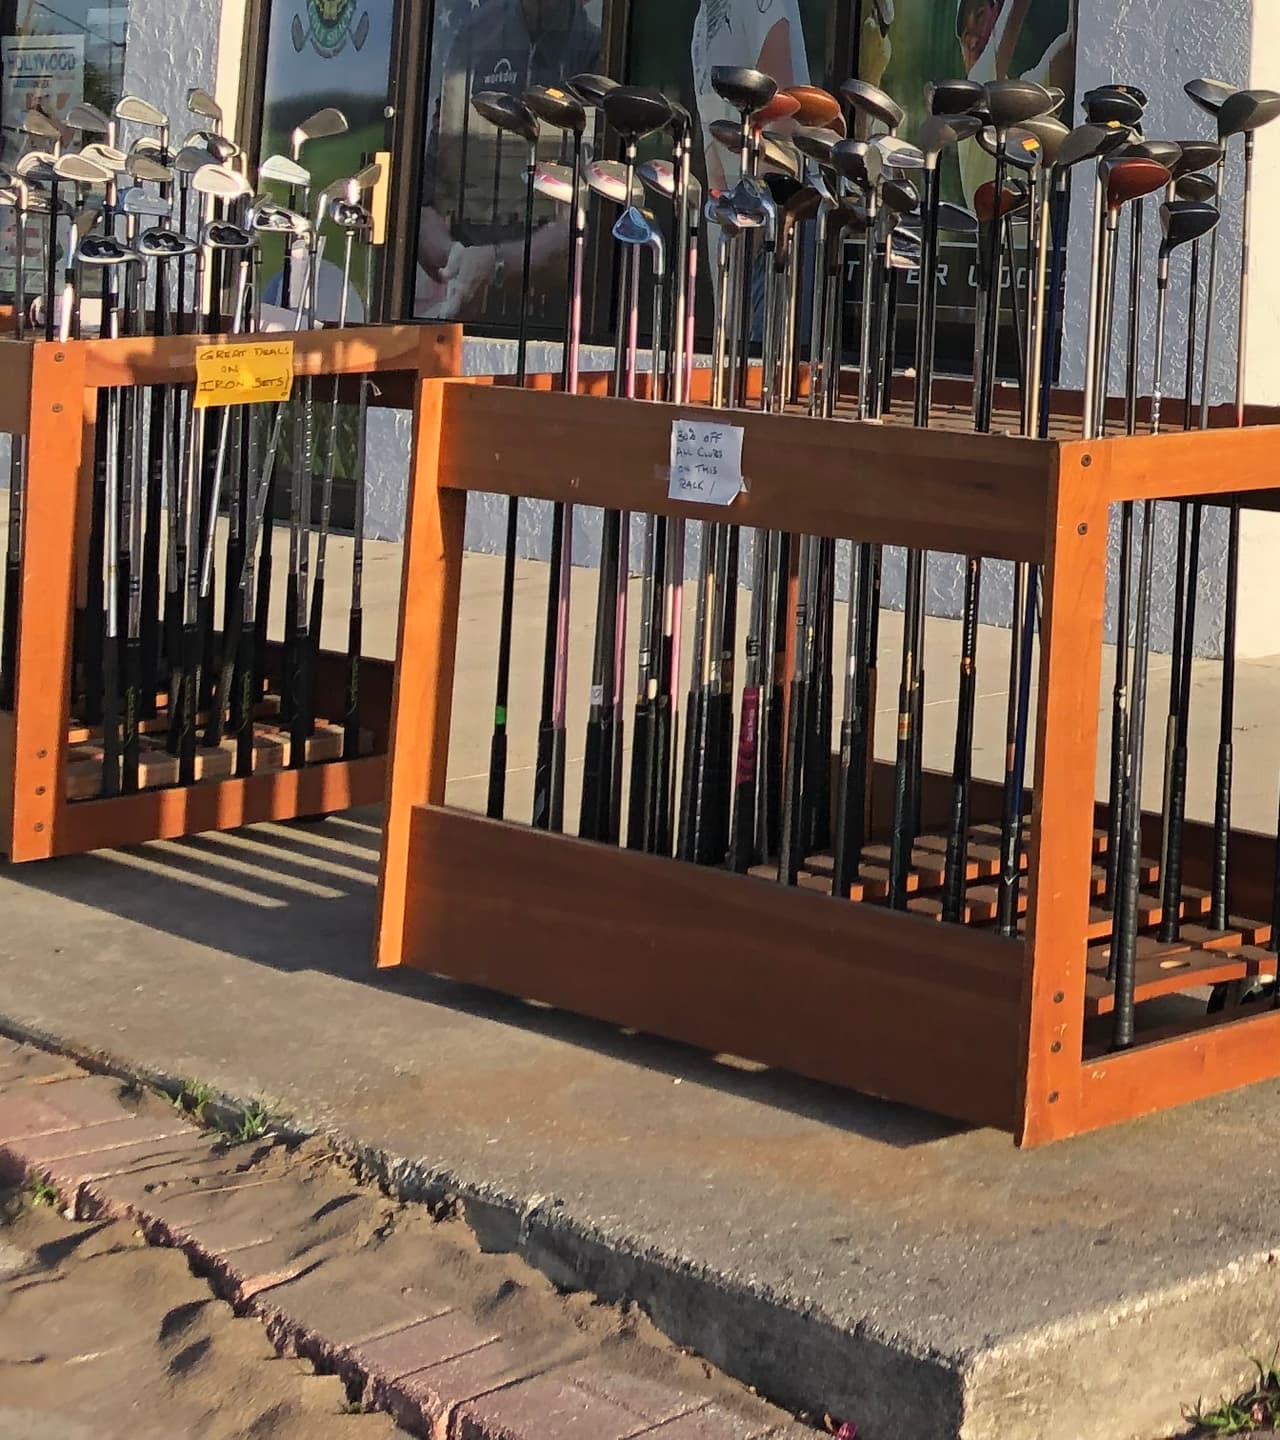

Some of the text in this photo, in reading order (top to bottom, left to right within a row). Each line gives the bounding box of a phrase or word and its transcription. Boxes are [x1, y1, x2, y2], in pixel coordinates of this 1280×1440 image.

[200, 349, 247, 360] GREAT
[221, 365, 239, 373] ON
[200, 380, 244, 391] IRON
